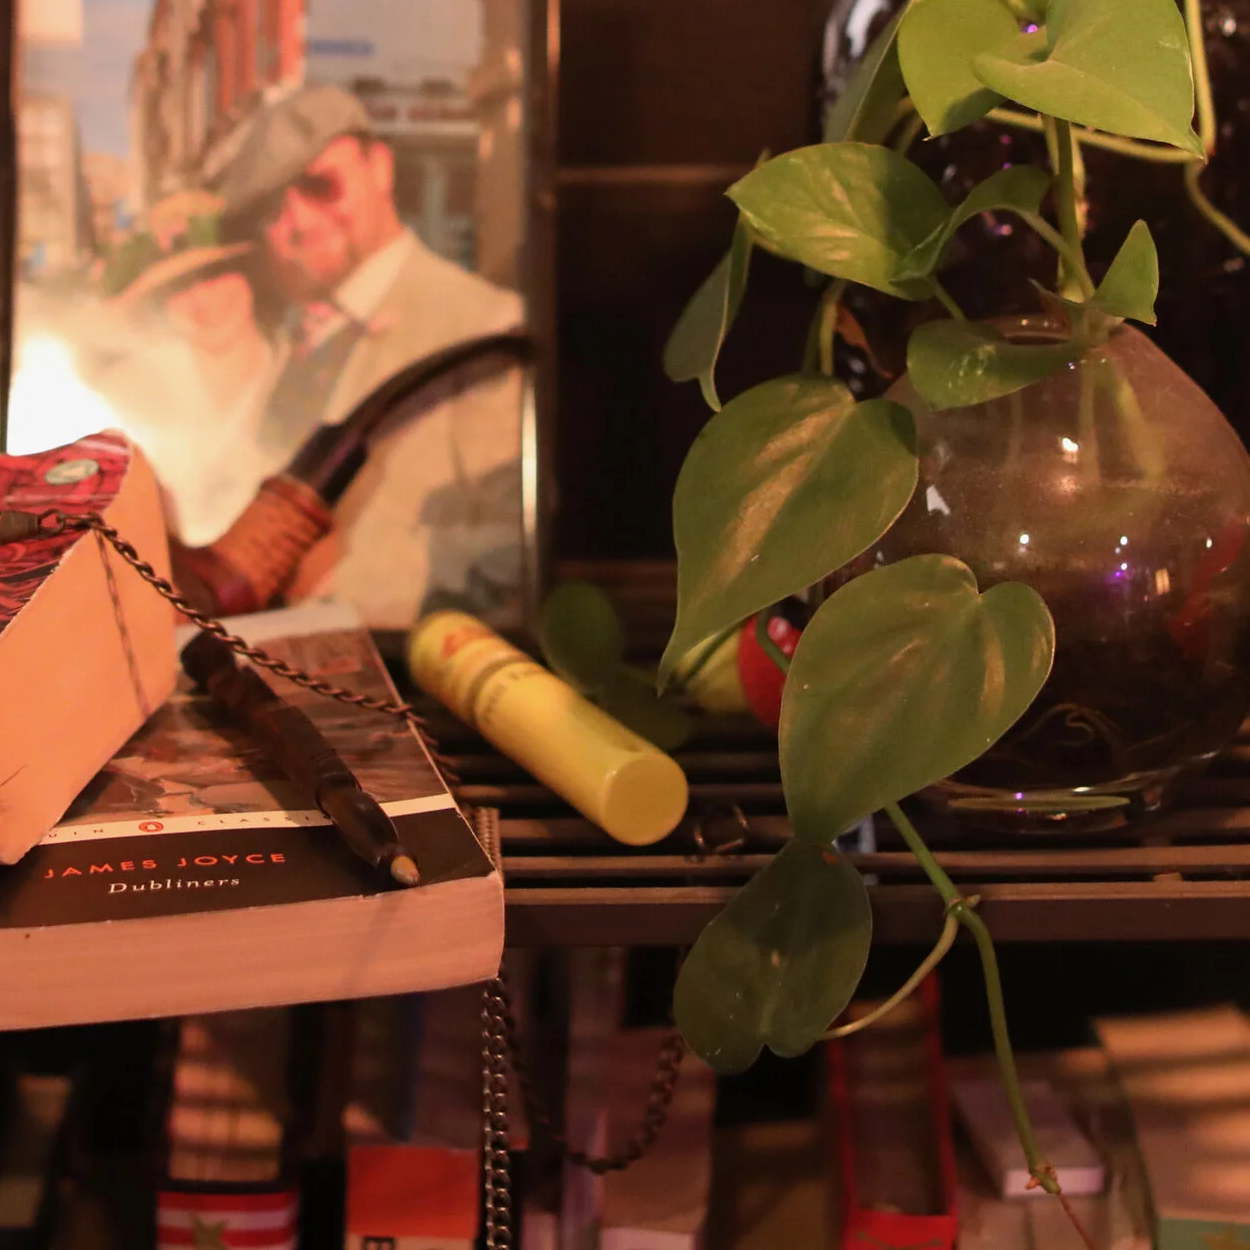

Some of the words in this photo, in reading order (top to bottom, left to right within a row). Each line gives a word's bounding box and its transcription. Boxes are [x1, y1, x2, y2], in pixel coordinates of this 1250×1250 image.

[44, 859, 158, 880] JAMES
[177, 852, 287, 867] JOYCE
[108, 877, 240, 894] Dubliners
